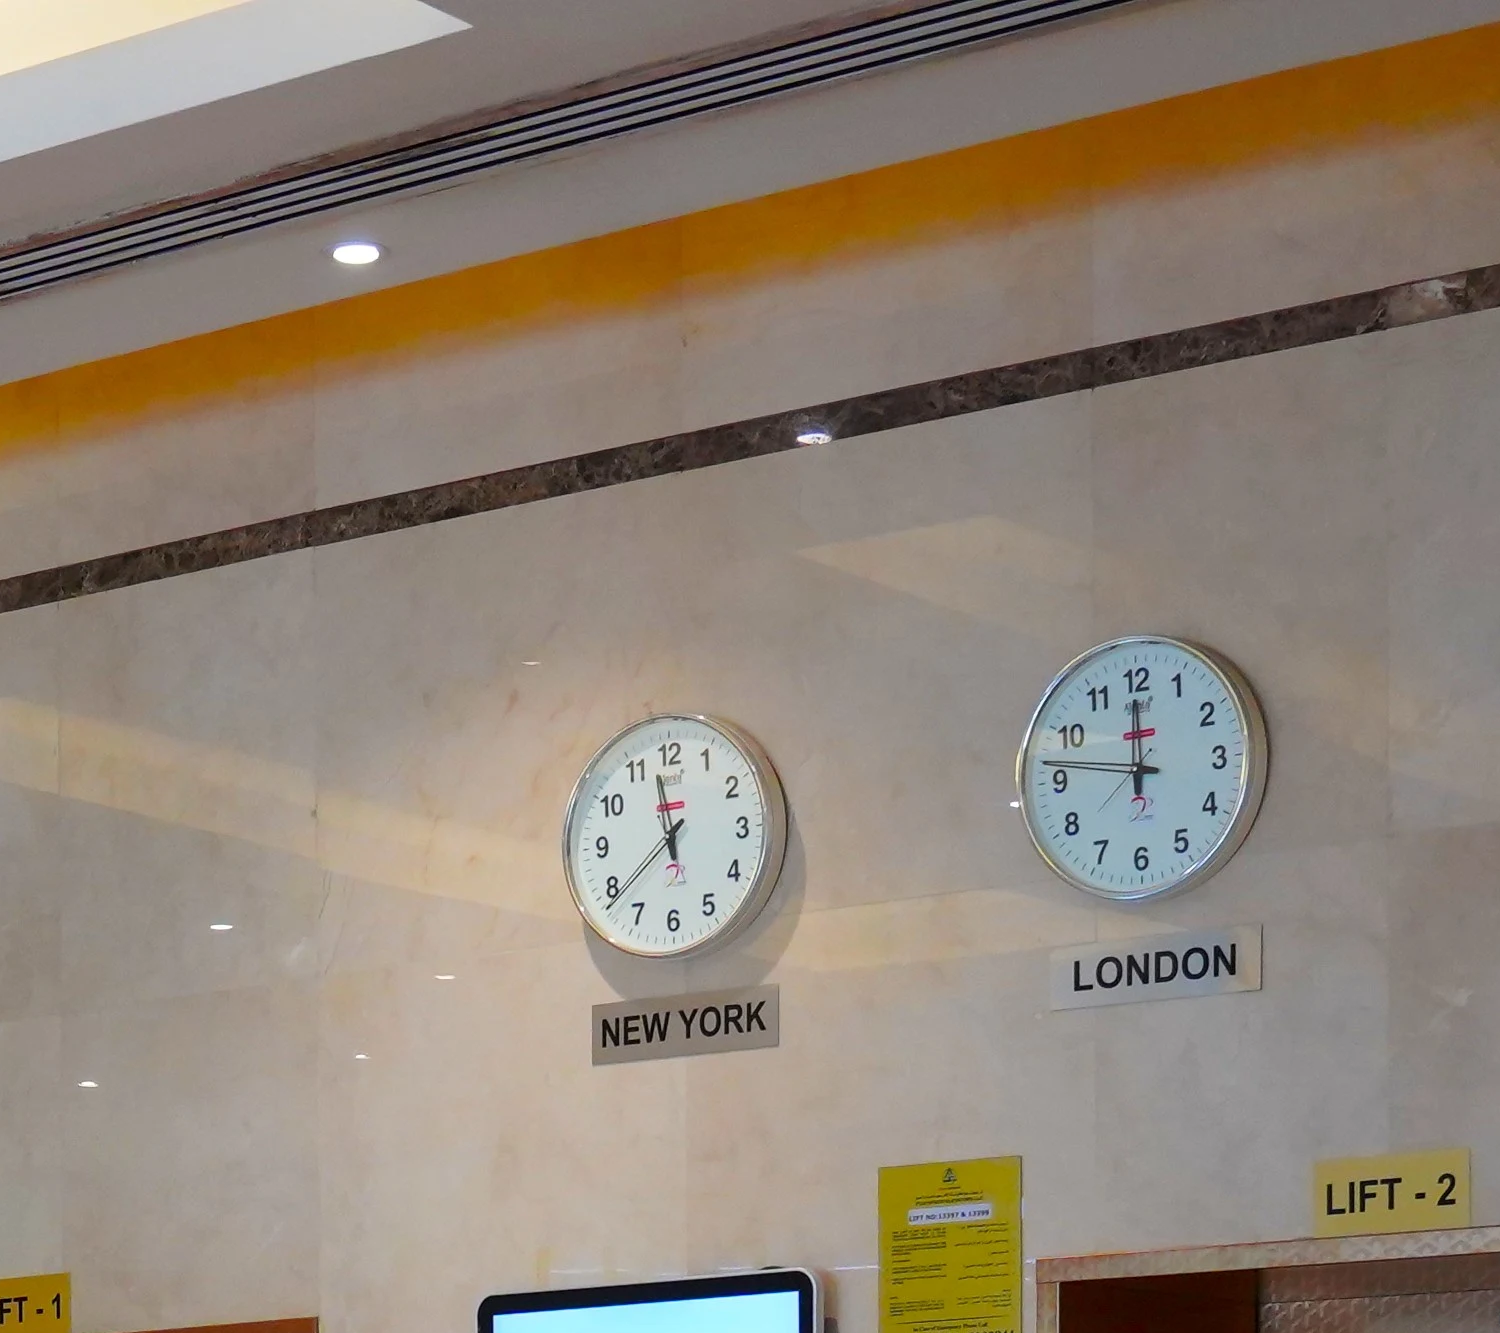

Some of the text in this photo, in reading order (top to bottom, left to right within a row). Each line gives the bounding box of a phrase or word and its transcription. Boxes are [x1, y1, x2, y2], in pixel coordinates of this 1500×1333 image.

[1123, 667, 1150, 693] 12
[1171, 673, 1182, 697] 1
[1086, 686, 1109, 712] 11
[1200, 702, 1214, 726] 2
[1058, 724, 1084, 749] 10
[658, 742, 681, 767] 12
[700, 748, 710, 771] 1
[1212, 746, 1227, 769] 3
[626, 759, 646, 783] 11
[1053, 770, 1067, 793] 9
[726, 776, 739, 799] 2
[600, 794, 624, 818] 10
[1203, 791, 1217, 816] 4
[736, 817, 749, 839] 3
[1065, 812, 1079, 835] 8
[596, 836, 609, 858] 9
[1094, 840, 1109, 865] 7
[1174, 829, 1189, 853] 5
[727, 859, 740, 882] 4
[1134, 847, 1149, 870] 6
[606, 876, 619, 898] 8
[631, 902, 645, 925] 7
[702, 894, 716, 916] 5
[667, 910, 680, 931] 6
[1074, 943, 1237, 992] LONDON
[601, 1000, 767, 1048] NEW YORK
[1326, 1173, 1456, 1215] LIFT - 2
[51, 1292, 61, 1319] 1
